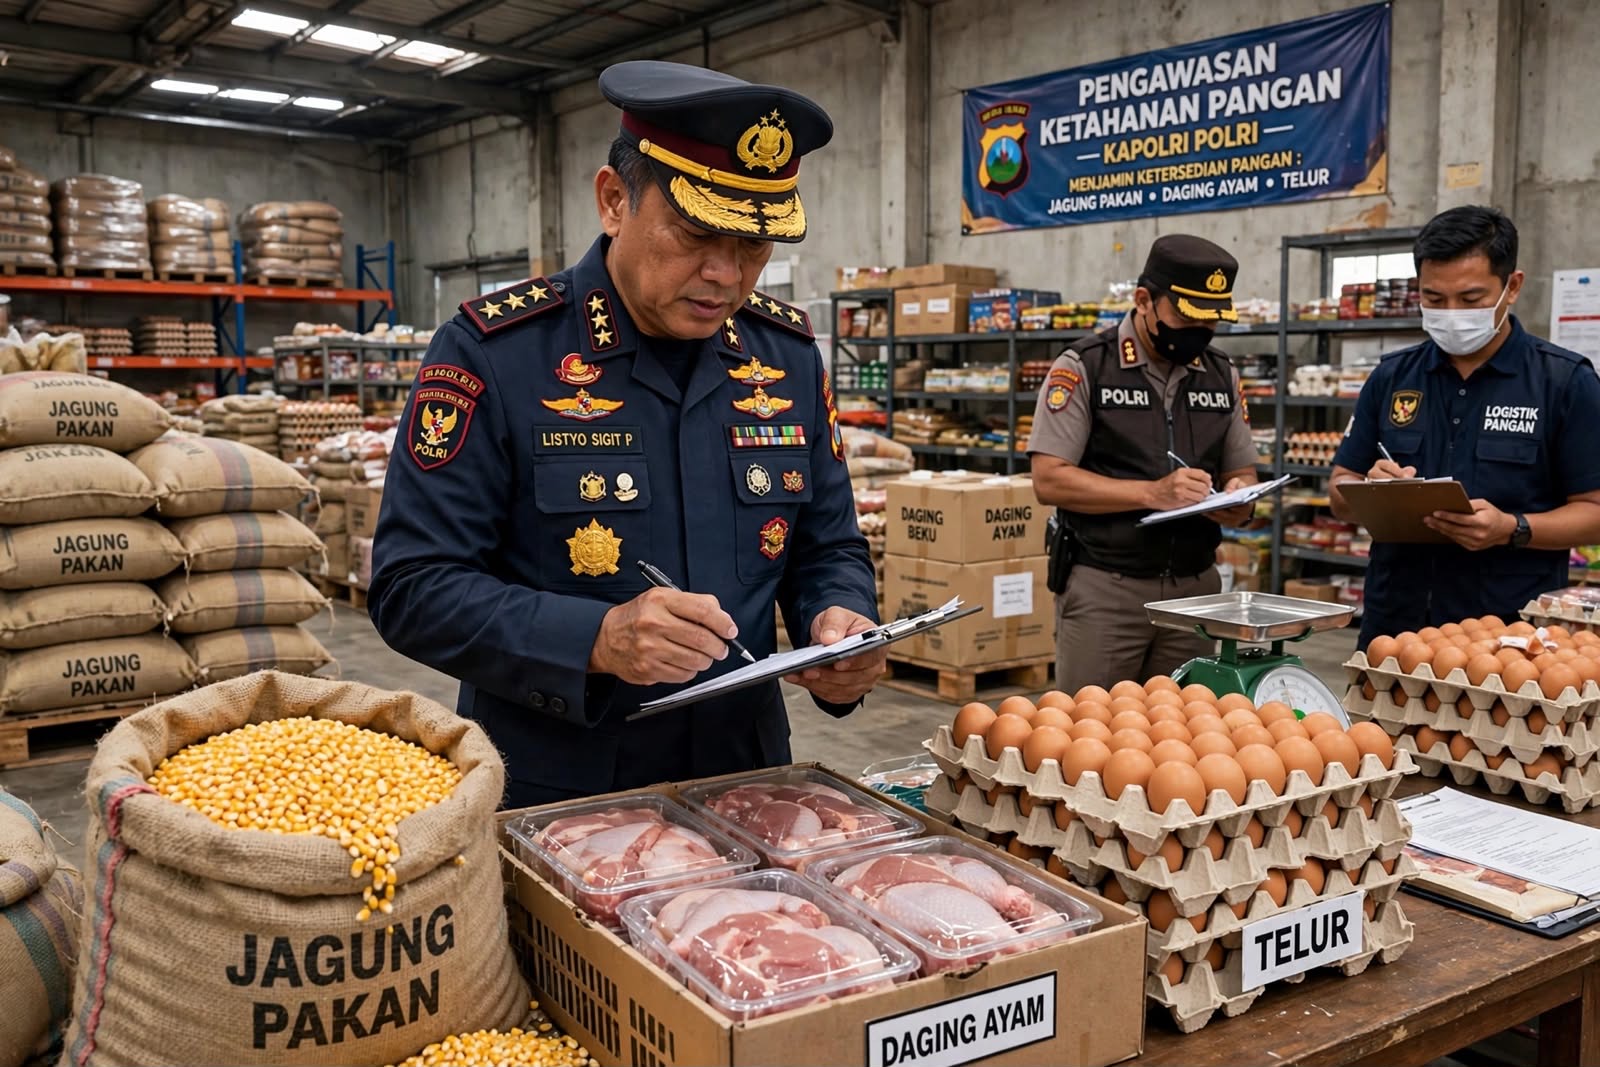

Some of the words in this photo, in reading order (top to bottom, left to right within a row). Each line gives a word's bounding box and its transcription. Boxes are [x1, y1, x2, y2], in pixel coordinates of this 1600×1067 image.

[1079, 42, 1277, 106] PENGAWASAN
[1039, 93, 1199, 146] KETAHANAN
[1208, 67, 1342, 119] PANGAN
[1103, 131, 1189, 164] KAPOLRI
[1194, 121, 1259, 151] POLRI
[1069, 171, 1134, 192] MENJAMIN
[1137, 159, 1228, 185] KETERSEDIAN
[1231, 152, 1292, 173] PANGAN
[1047, 195, 1097, 214] JAGUNG
[1099, 190, 1143, 209] PAKAN
[1162, 182, 1215, 202] DAGING
[1217, 177, 1258, 194] AYAM
[1281, 168, 1330, 189] TELUR
[1101, 388, 1149, 406] POLRI
[1188, 391, 1230, 408] POLRI
[49, 401, 118, 417] JAGUNG
[1485, 405, 1539, 420] LOGISTIK
[56, 420, 114, 437] PAKAN
[1483, 418, 1535, 434] PANGAN
[542, 432, 587, 446] LISTYO
[591, 432, 621, 446] SIGIT
[625, 433, 633, 446] P
[414, 442, 448, 459] POLRI
[901, 507, 943, 525] DAGING
[985, 506, 1032, 523] DAGING
[908, 525, 937, 542] BEKU
[992, 524, 1026, 541] AYAM
[53, 533, 129, 554] JAGUNG
[61, 554, 124, 575] PAKAN
[62, 653, 141, 679] JAGUNG
[71, 675, 135, 697] PAKAN
[226, 904, 455, 987] JAGUNG
[1255, 908, 1350, 972] TELUR
[252, 969, 440, 1050] PAKAN
[882, 1014, 976, 1067] DAGING
[983, 994, 1044, 1039] AYAM
